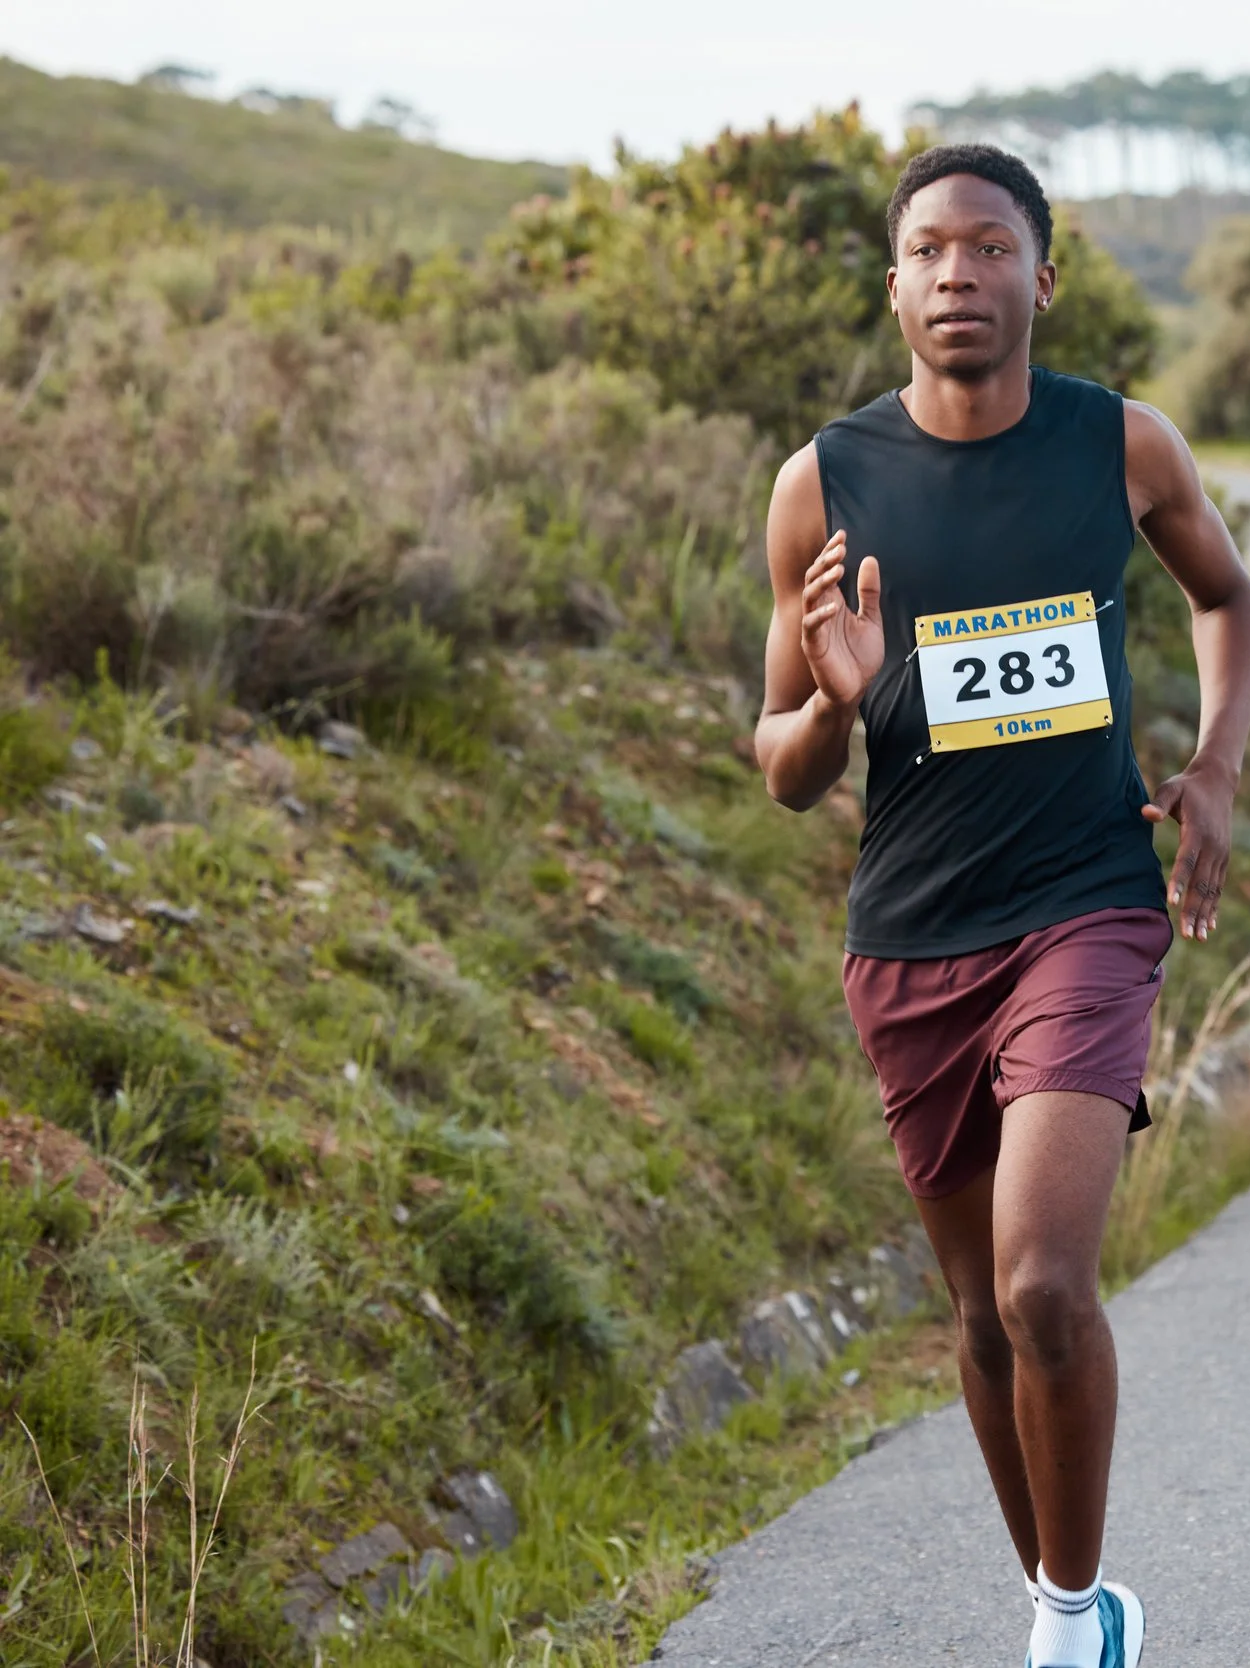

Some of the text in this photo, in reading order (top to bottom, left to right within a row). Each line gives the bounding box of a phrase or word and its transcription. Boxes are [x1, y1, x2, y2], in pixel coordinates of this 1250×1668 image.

[933, 601, 1076, 637] MARATHON
[952, 643, 1076, 703] 283
[993, 718, 1053, 737] 10km
